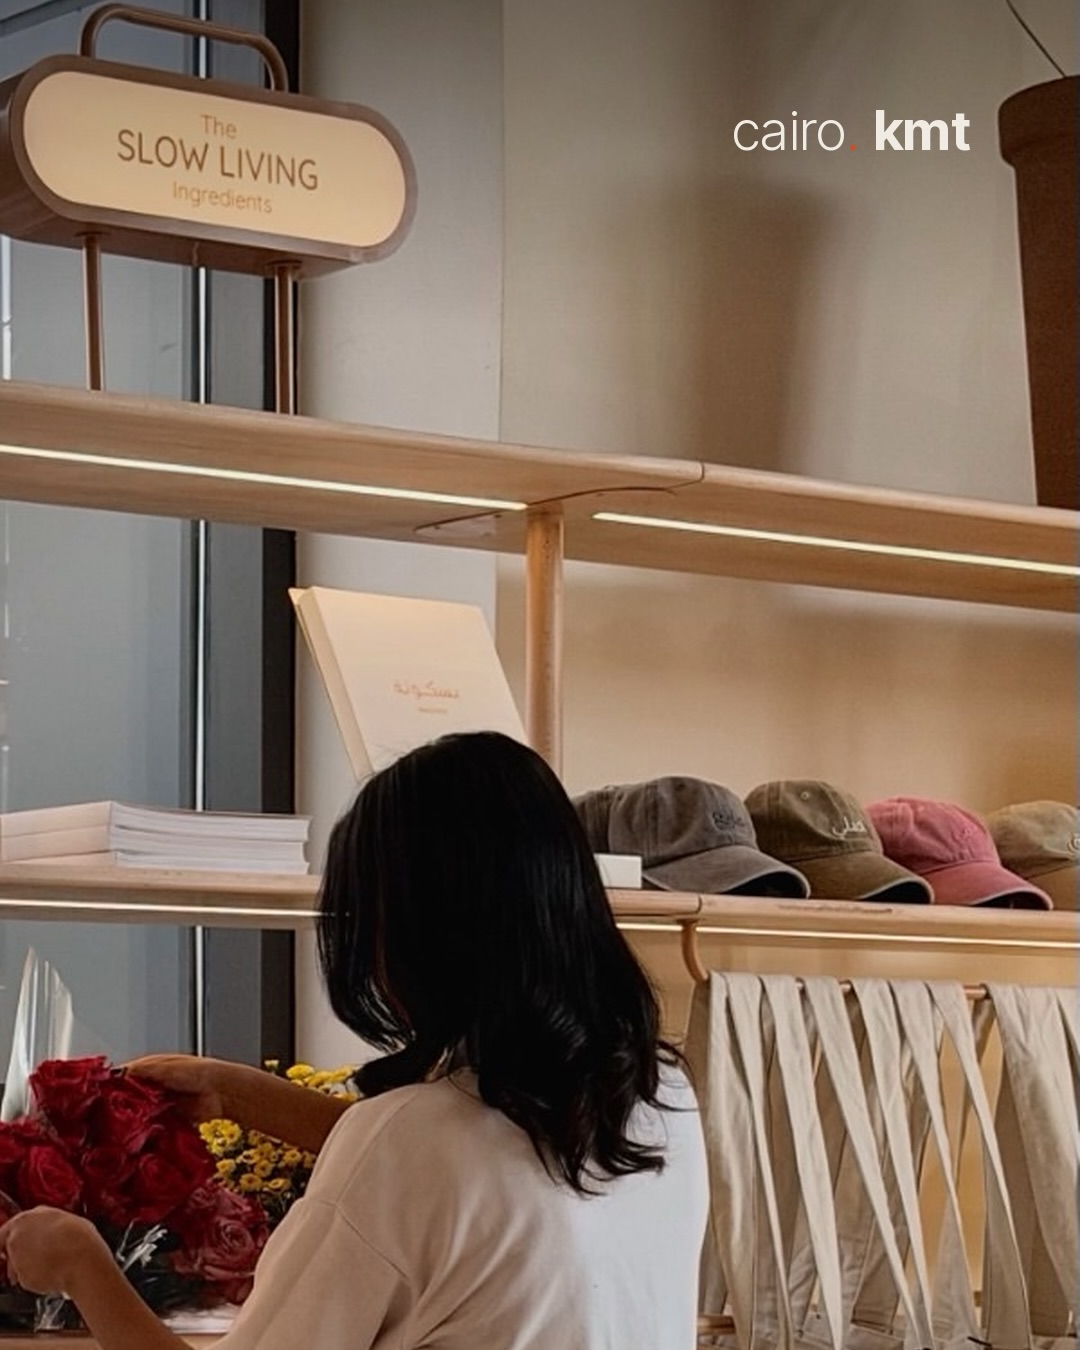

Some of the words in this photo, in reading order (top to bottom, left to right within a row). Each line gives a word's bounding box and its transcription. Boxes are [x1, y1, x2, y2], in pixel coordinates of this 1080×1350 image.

[201, 115, 237, 140] The
[117, 129, 208, 172] SLOW
[220, 144, 319, 190] LIVING
[172, 181, 273, 214] Ingredients
